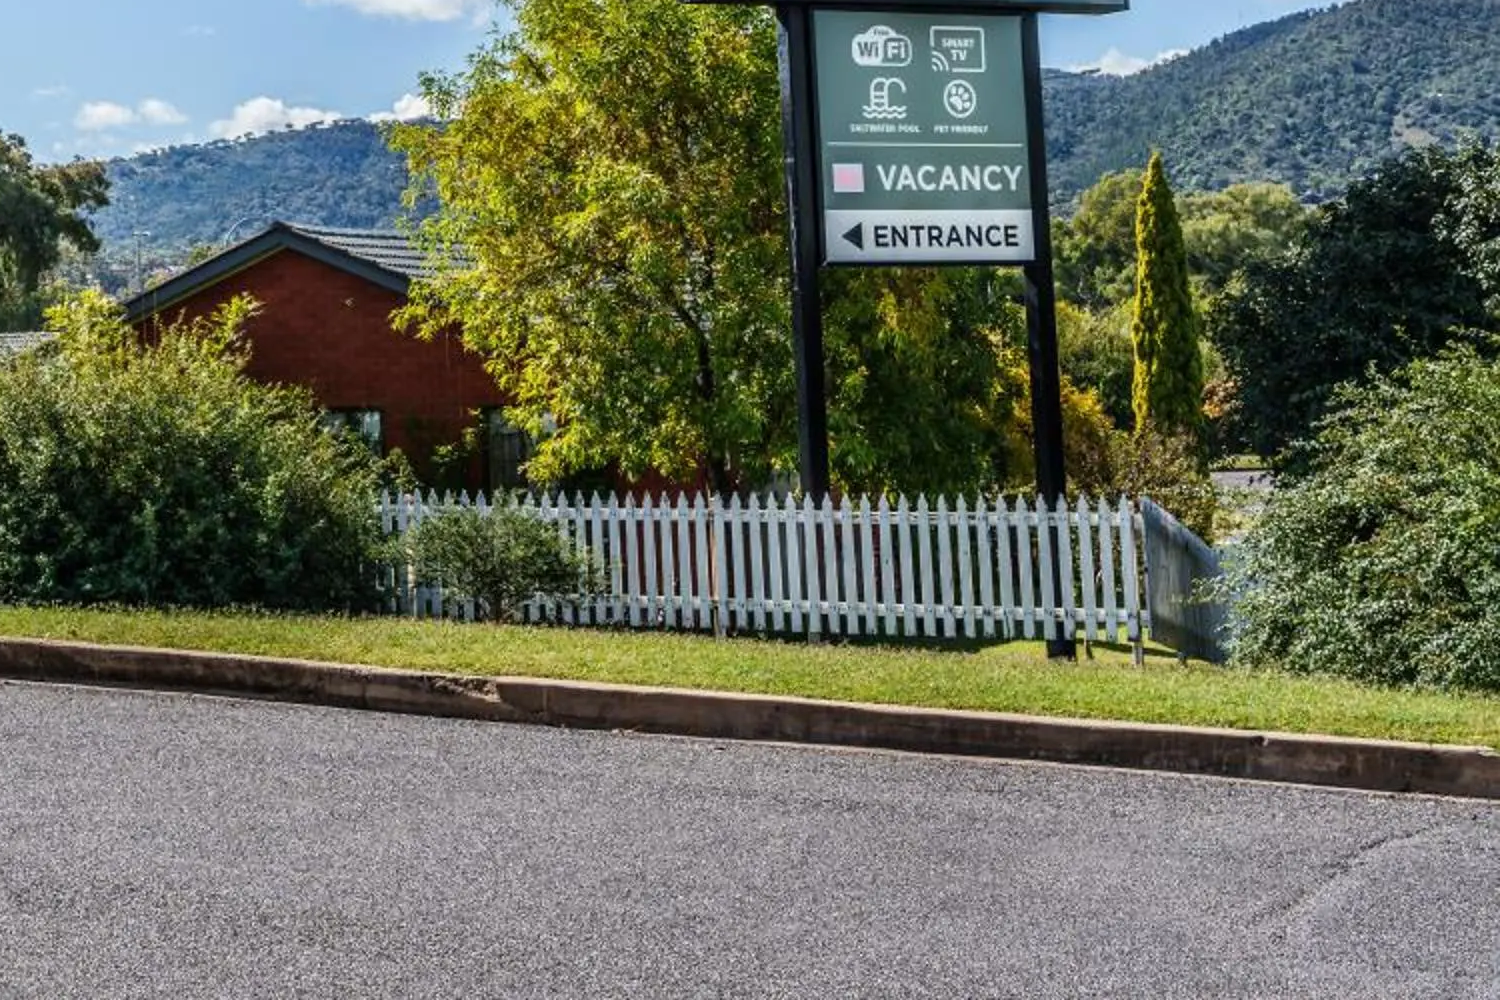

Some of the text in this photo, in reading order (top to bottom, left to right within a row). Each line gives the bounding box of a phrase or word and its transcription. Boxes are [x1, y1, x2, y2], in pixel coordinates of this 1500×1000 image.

[950, 49, 967, 61] TV
[876, 164, 1023, 191] VACANCY
[873, 225, 1019, 248] ENTRANCE
